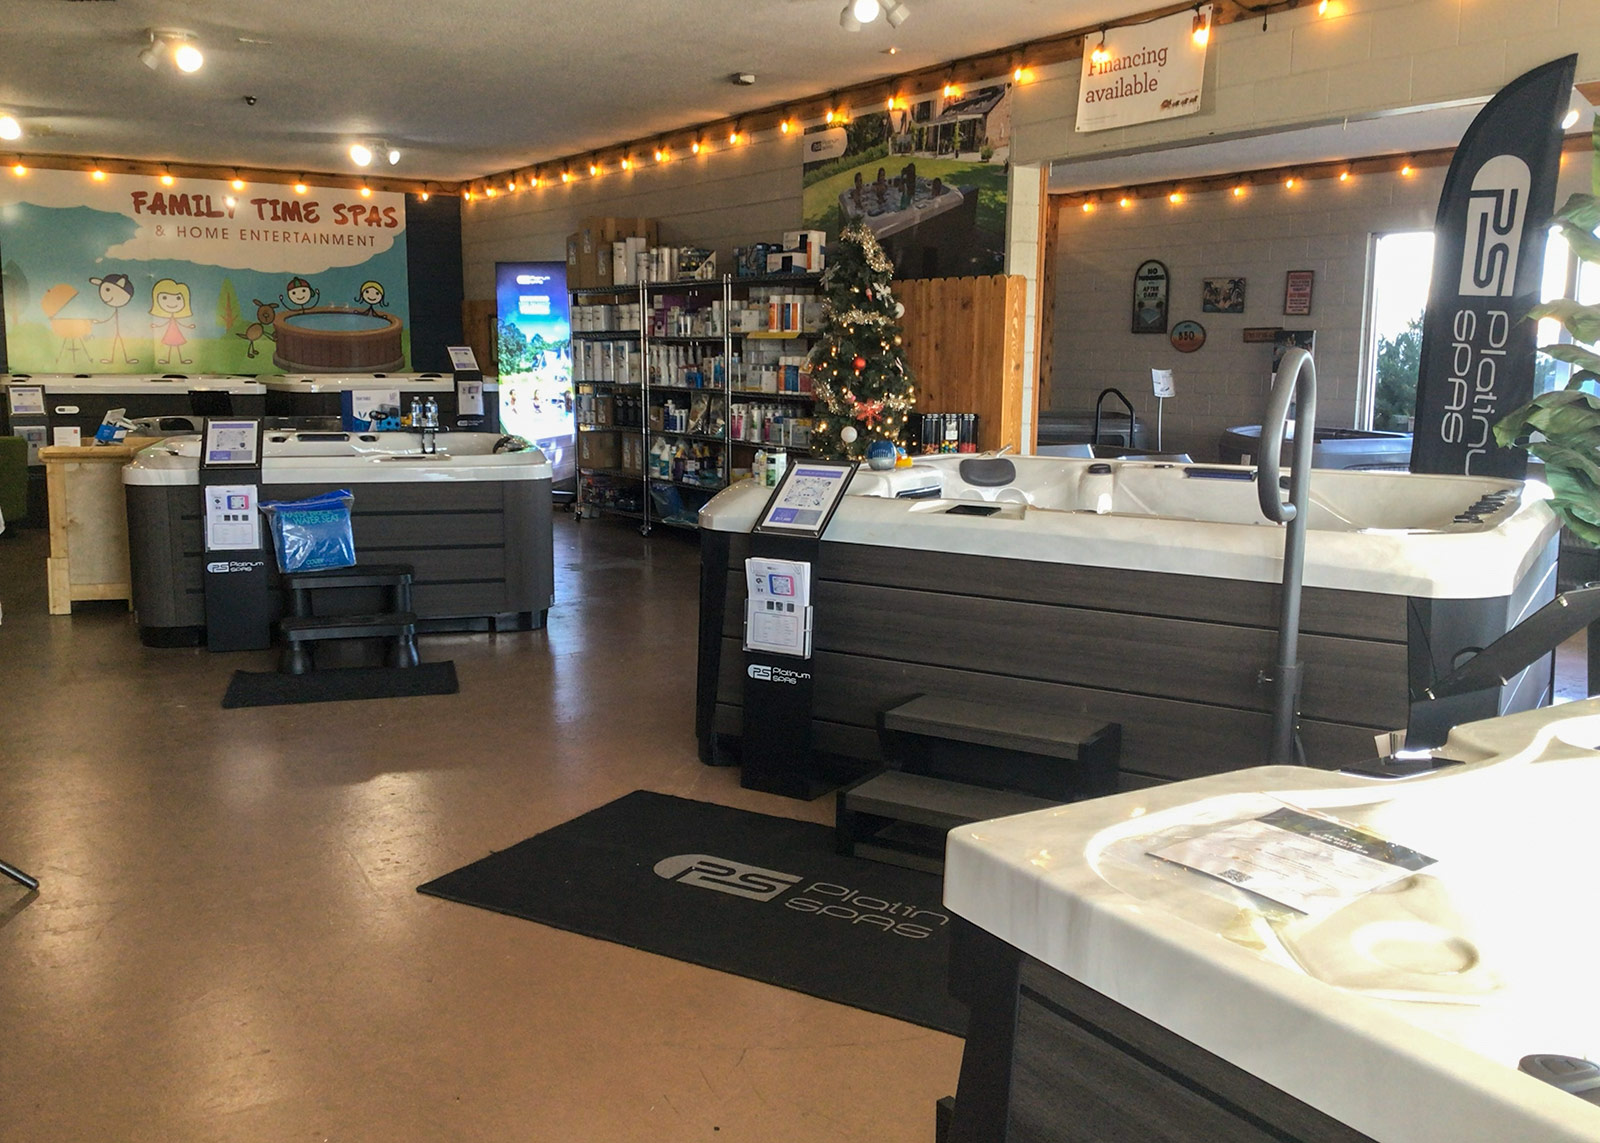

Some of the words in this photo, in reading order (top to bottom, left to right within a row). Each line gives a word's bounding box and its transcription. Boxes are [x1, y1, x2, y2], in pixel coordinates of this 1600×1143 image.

[1087, 46, 1168, 77] Financing
[1085, 72, 1158, 104] available
[131, 190, 236, 219] FAMILY
[250, 198, 320, 224] TIME
[333, 203, 399, 228] SPAS
[155, 225, 166, 237] &
[177, 226, 229, 240] HOME
[240, 229, 375, 248] ENTERTAINMENT
[1465, 310, 1509, 476] Platinu
[803, 882, 950, 926] Platin
